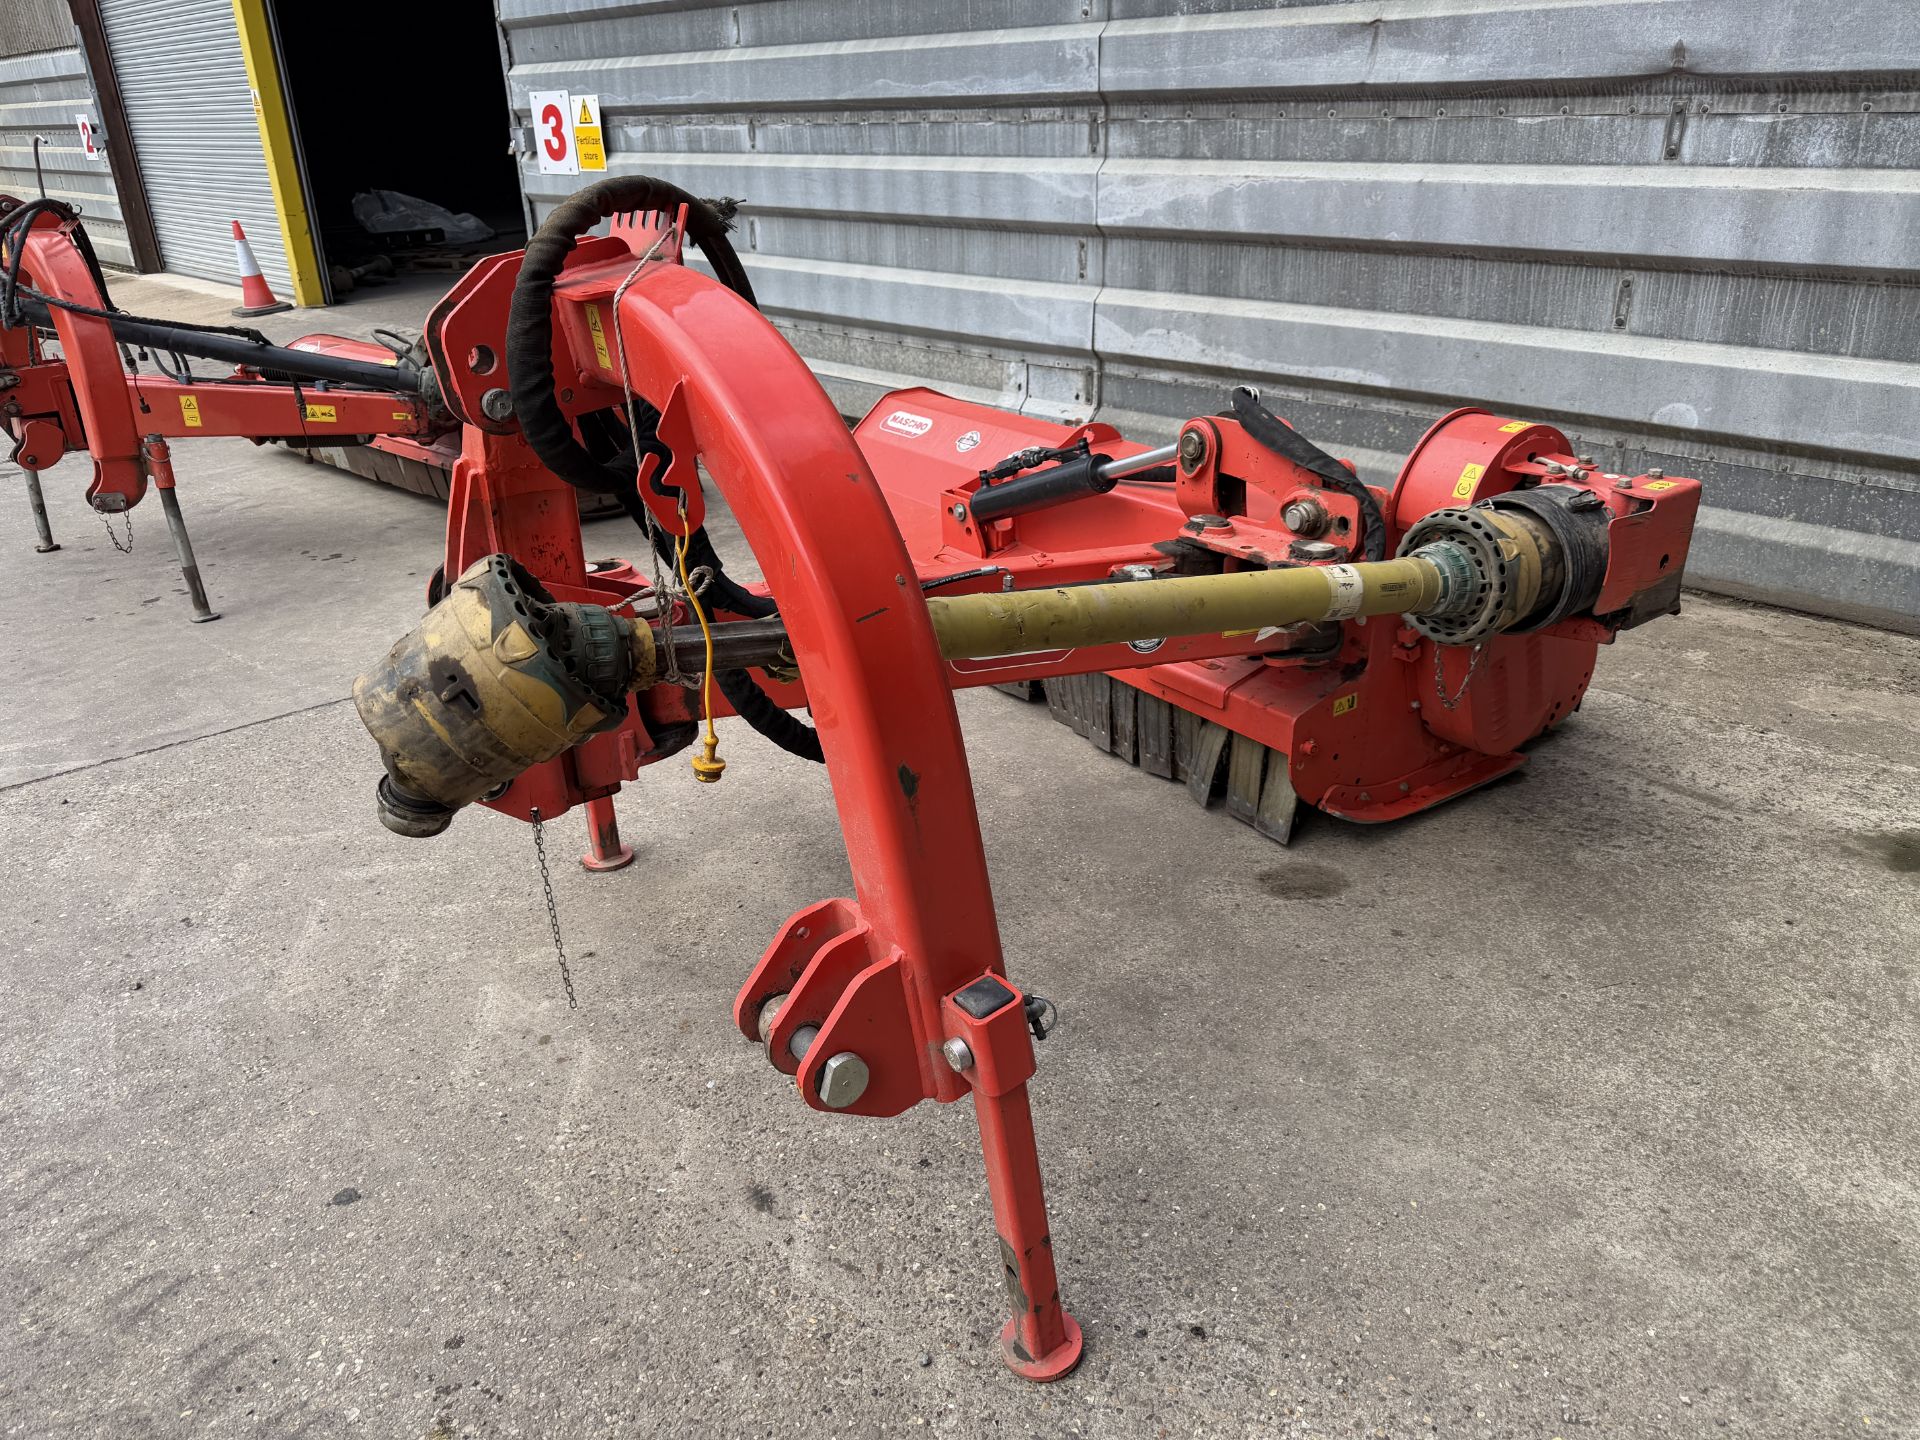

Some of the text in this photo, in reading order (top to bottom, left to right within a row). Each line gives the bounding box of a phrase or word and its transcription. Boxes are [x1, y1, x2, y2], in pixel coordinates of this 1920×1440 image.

[81, 122, 95, 153] 2
[542, 104, 567, 161] 3
[584, 152, 598, 160] store
[889, 415, 928, 431] MASCHIO
